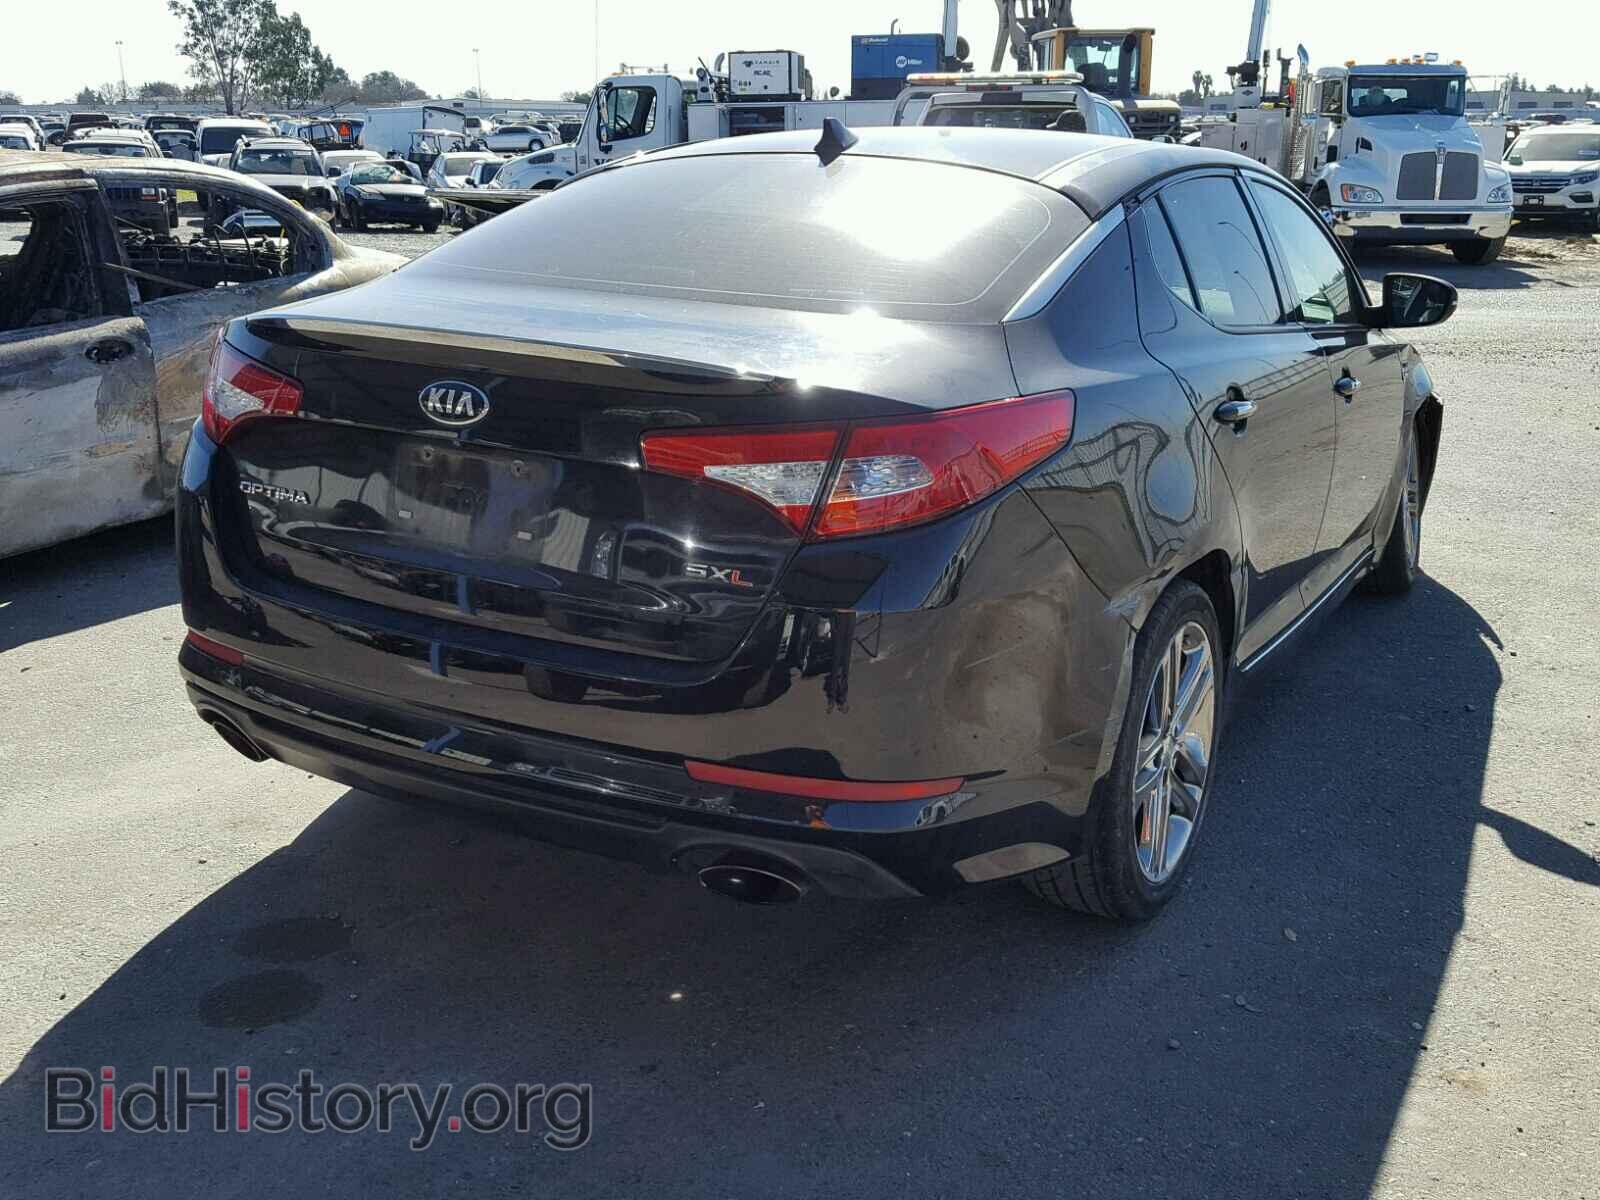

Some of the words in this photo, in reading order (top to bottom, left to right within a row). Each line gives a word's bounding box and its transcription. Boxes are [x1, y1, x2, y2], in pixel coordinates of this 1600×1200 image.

[427, 387, 475, 417] KIA
[239, 480, 309, 504] OPTIMA
[683, 562, 753, 588] SXL
